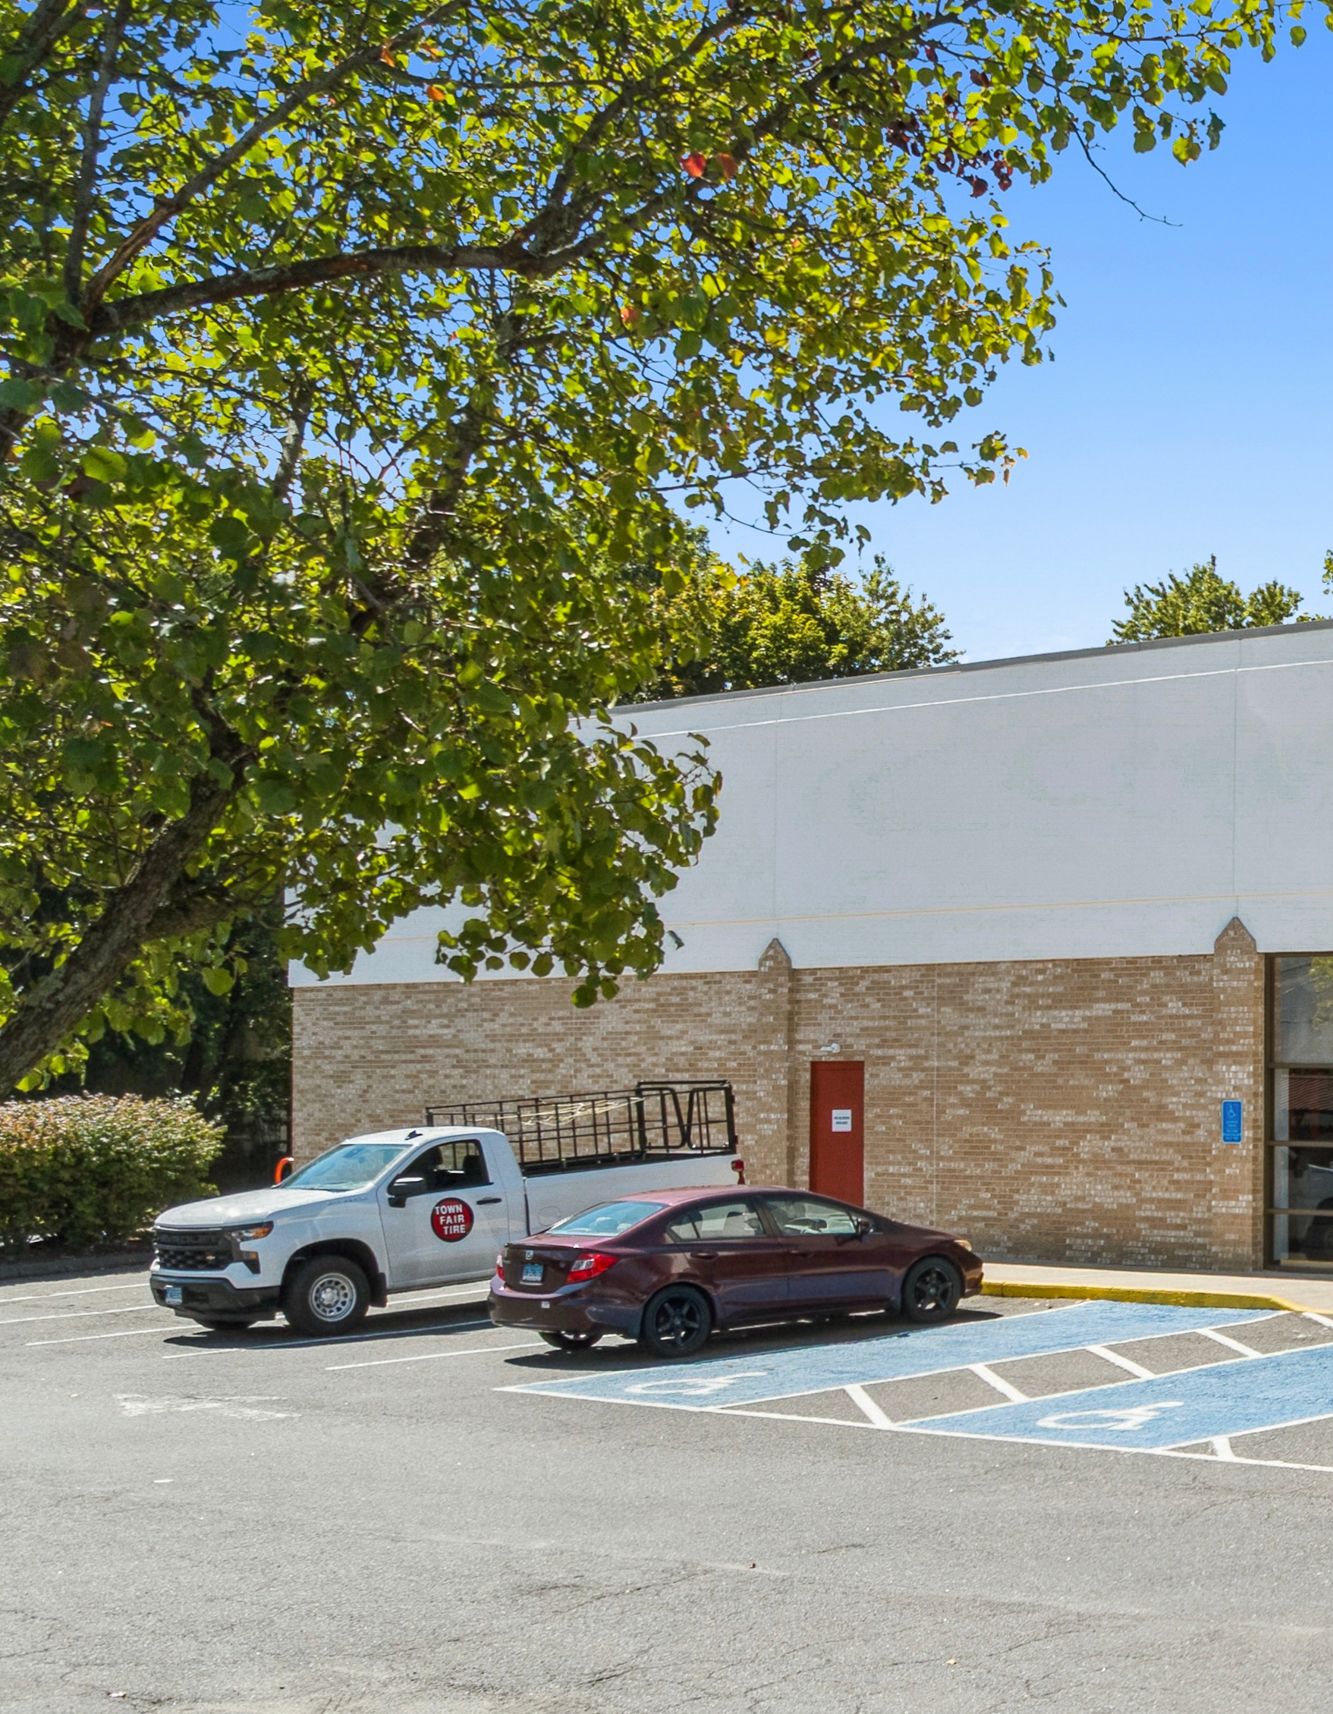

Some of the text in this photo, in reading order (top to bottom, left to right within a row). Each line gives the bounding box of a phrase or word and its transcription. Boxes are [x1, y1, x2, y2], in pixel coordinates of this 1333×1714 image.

[435, 1204, 463, 1215] TOWN
[440, 1214, 465, 1225] FAIR
[443, 1224, 466, 1235] TIRE
